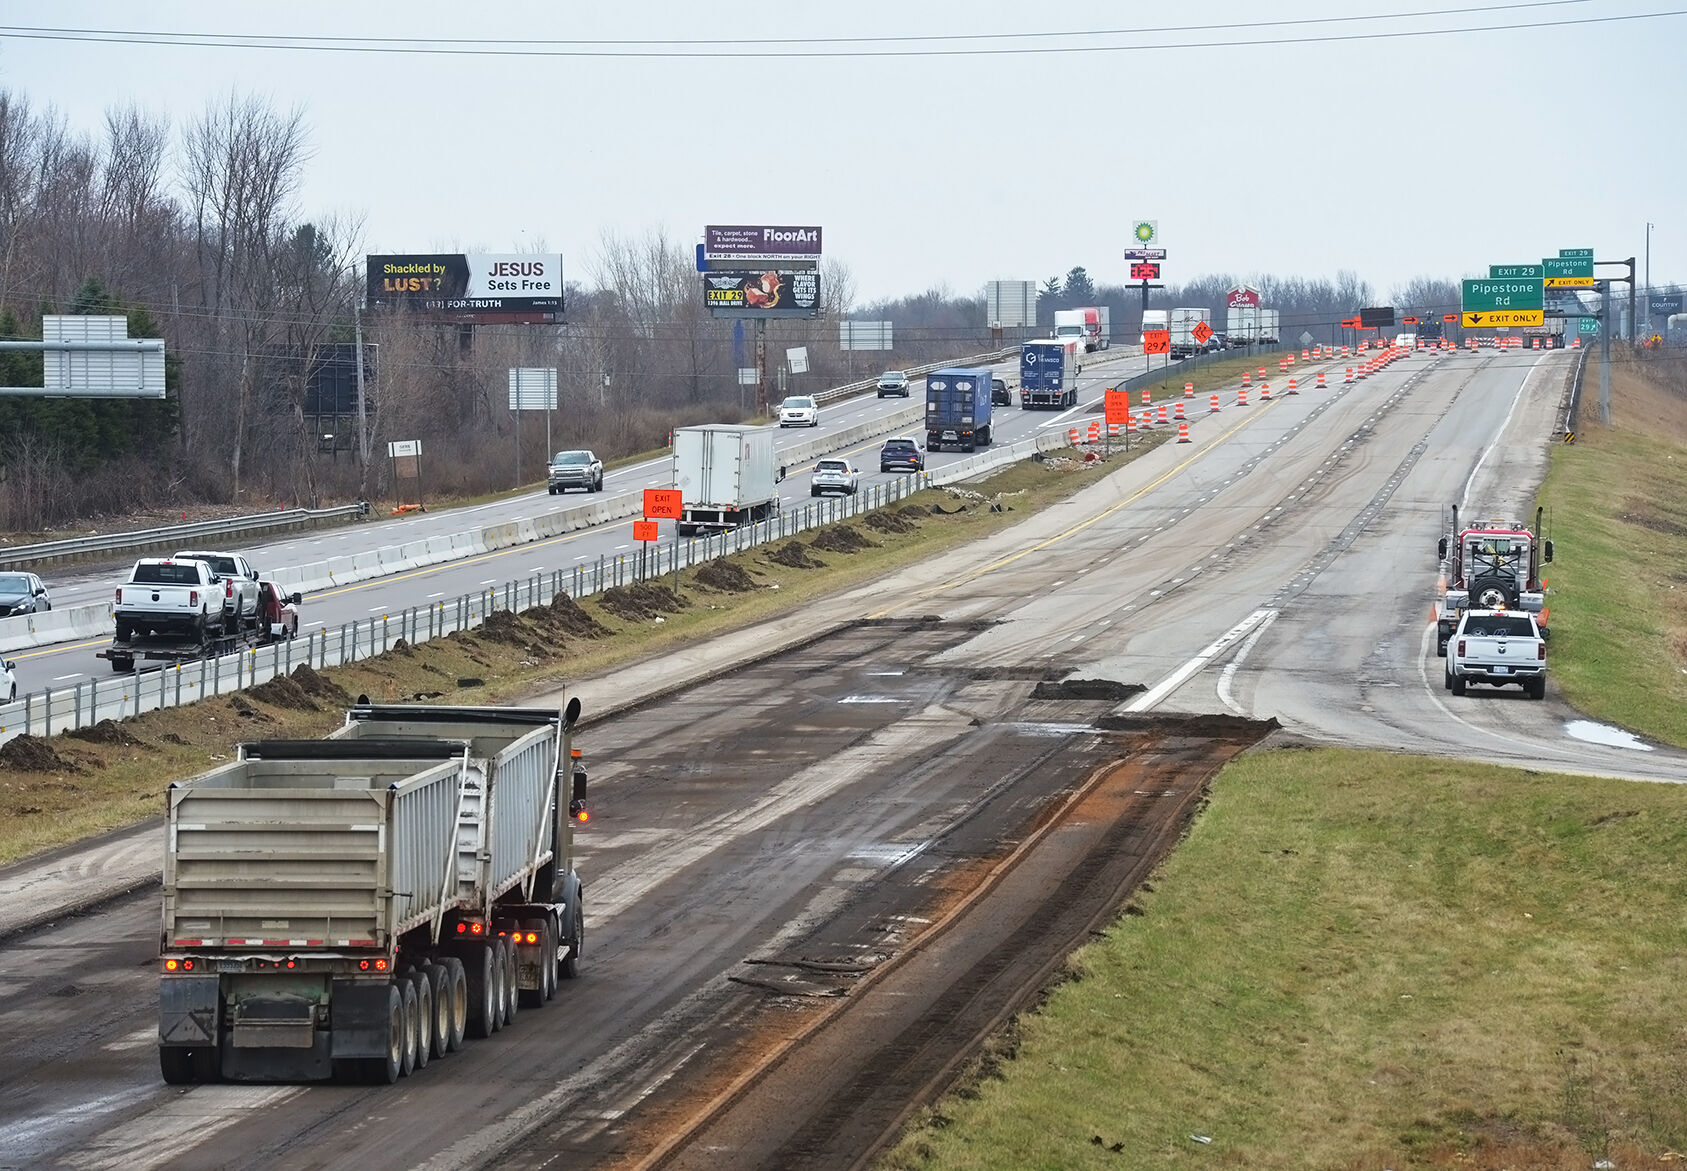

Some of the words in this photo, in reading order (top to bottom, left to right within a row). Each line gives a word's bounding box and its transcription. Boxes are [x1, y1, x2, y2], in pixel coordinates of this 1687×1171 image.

[764, 228, 818, 242] FloorArt
[384, 263, 430, 274] Shackled
[433, 264, 446, 276] by
[488, 262, 544, 277] JESUS
[384, 278, 442, 292] LUST?
[488, 280, 517, 290] Sets
[522, 280, 550, 290] Free
[1472, 284, 1534, 295] Pipestone
[708, 291, 729, 300] EXIT
[731, 291, 743, 300] 29
[1235, 294, 1250, 302] Bob
[448, 300, 502, 308] FOR-TRUTH
[1496, 296, 1510, 306] Rd
